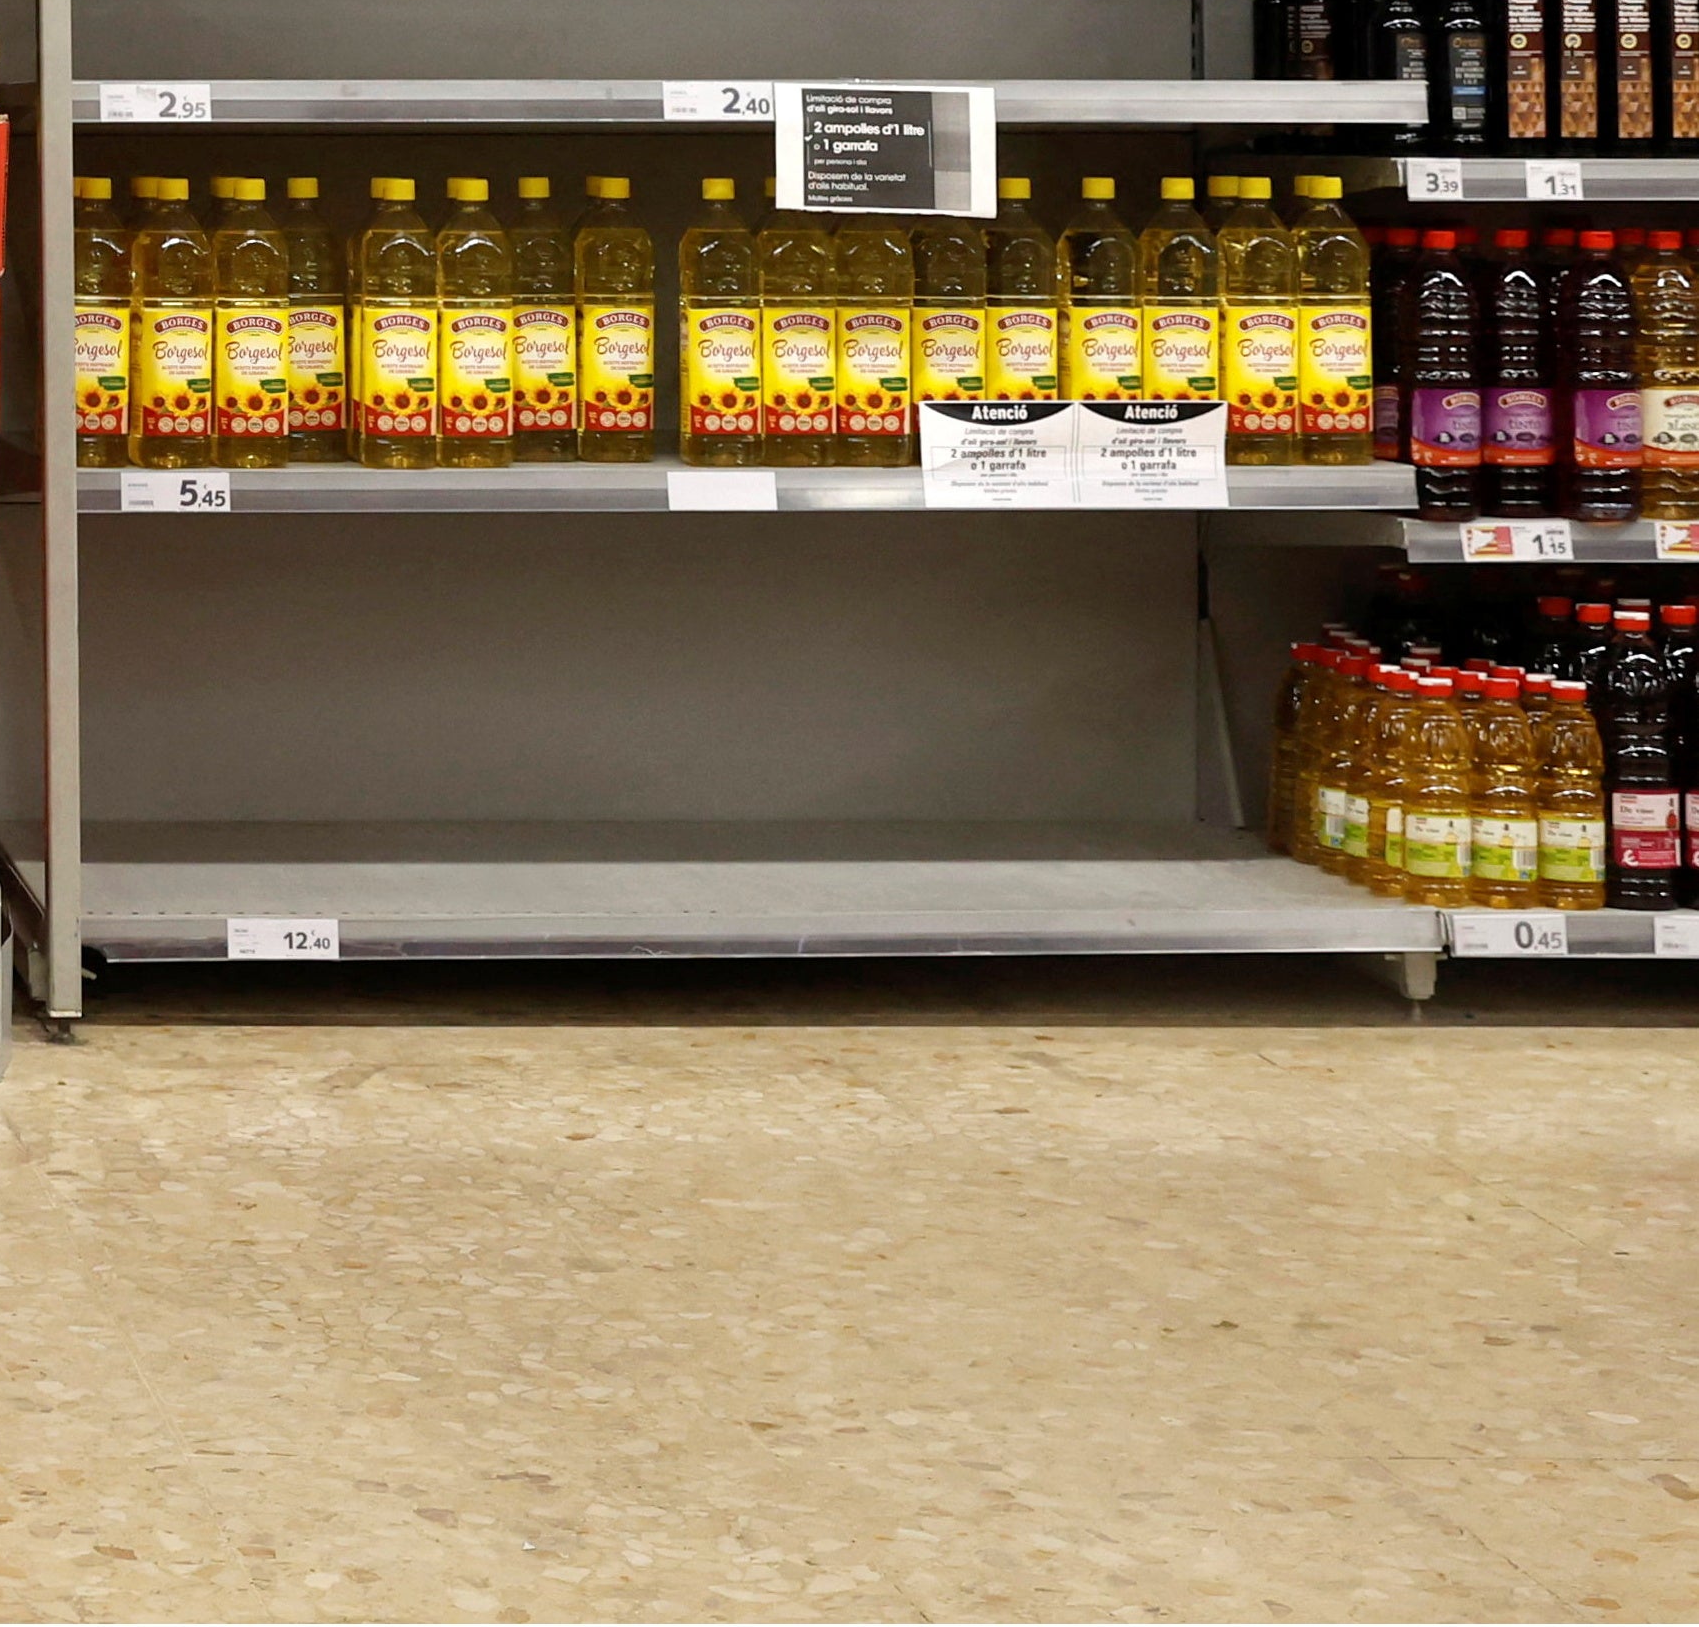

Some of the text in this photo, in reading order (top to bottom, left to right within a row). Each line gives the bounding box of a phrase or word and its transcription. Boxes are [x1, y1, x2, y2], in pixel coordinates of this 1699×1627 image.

[814, 121, 822, 133] 2
[823, 139, 829, 150] 1
[972, 404, 1028, 420] Atenció
[1124, 404, 1178, 419] Atenció
